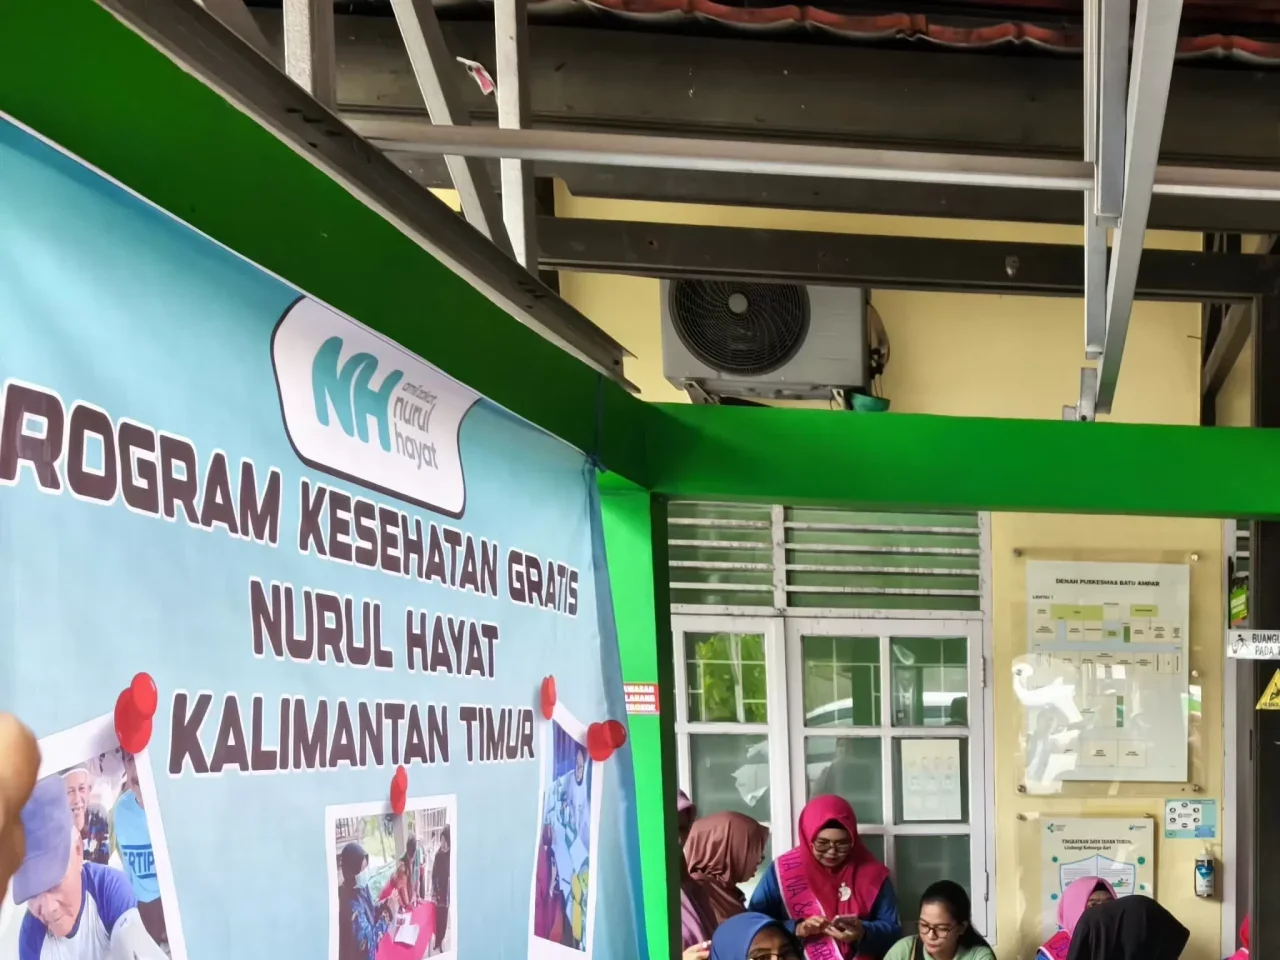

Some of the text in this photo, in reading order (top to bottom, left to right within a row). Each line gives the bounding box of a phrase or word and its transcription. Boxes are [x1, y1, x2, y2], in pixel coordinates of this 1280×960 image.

[311, 336, 404, 453] NH
[394, 396, 436, 433] nurul
[394, 421, 438, 470] hayat
[0, 383, 578, 615] ROGRAM KESEHATAN GRATIS
[250, 580, 499, 678] NURUL HAYAT
[1255, 646, 1275, 656] PADA
[168, 692, 535, 774] KALIMANTAN TIMUR
[123, 851, 154, 874] RTIP
